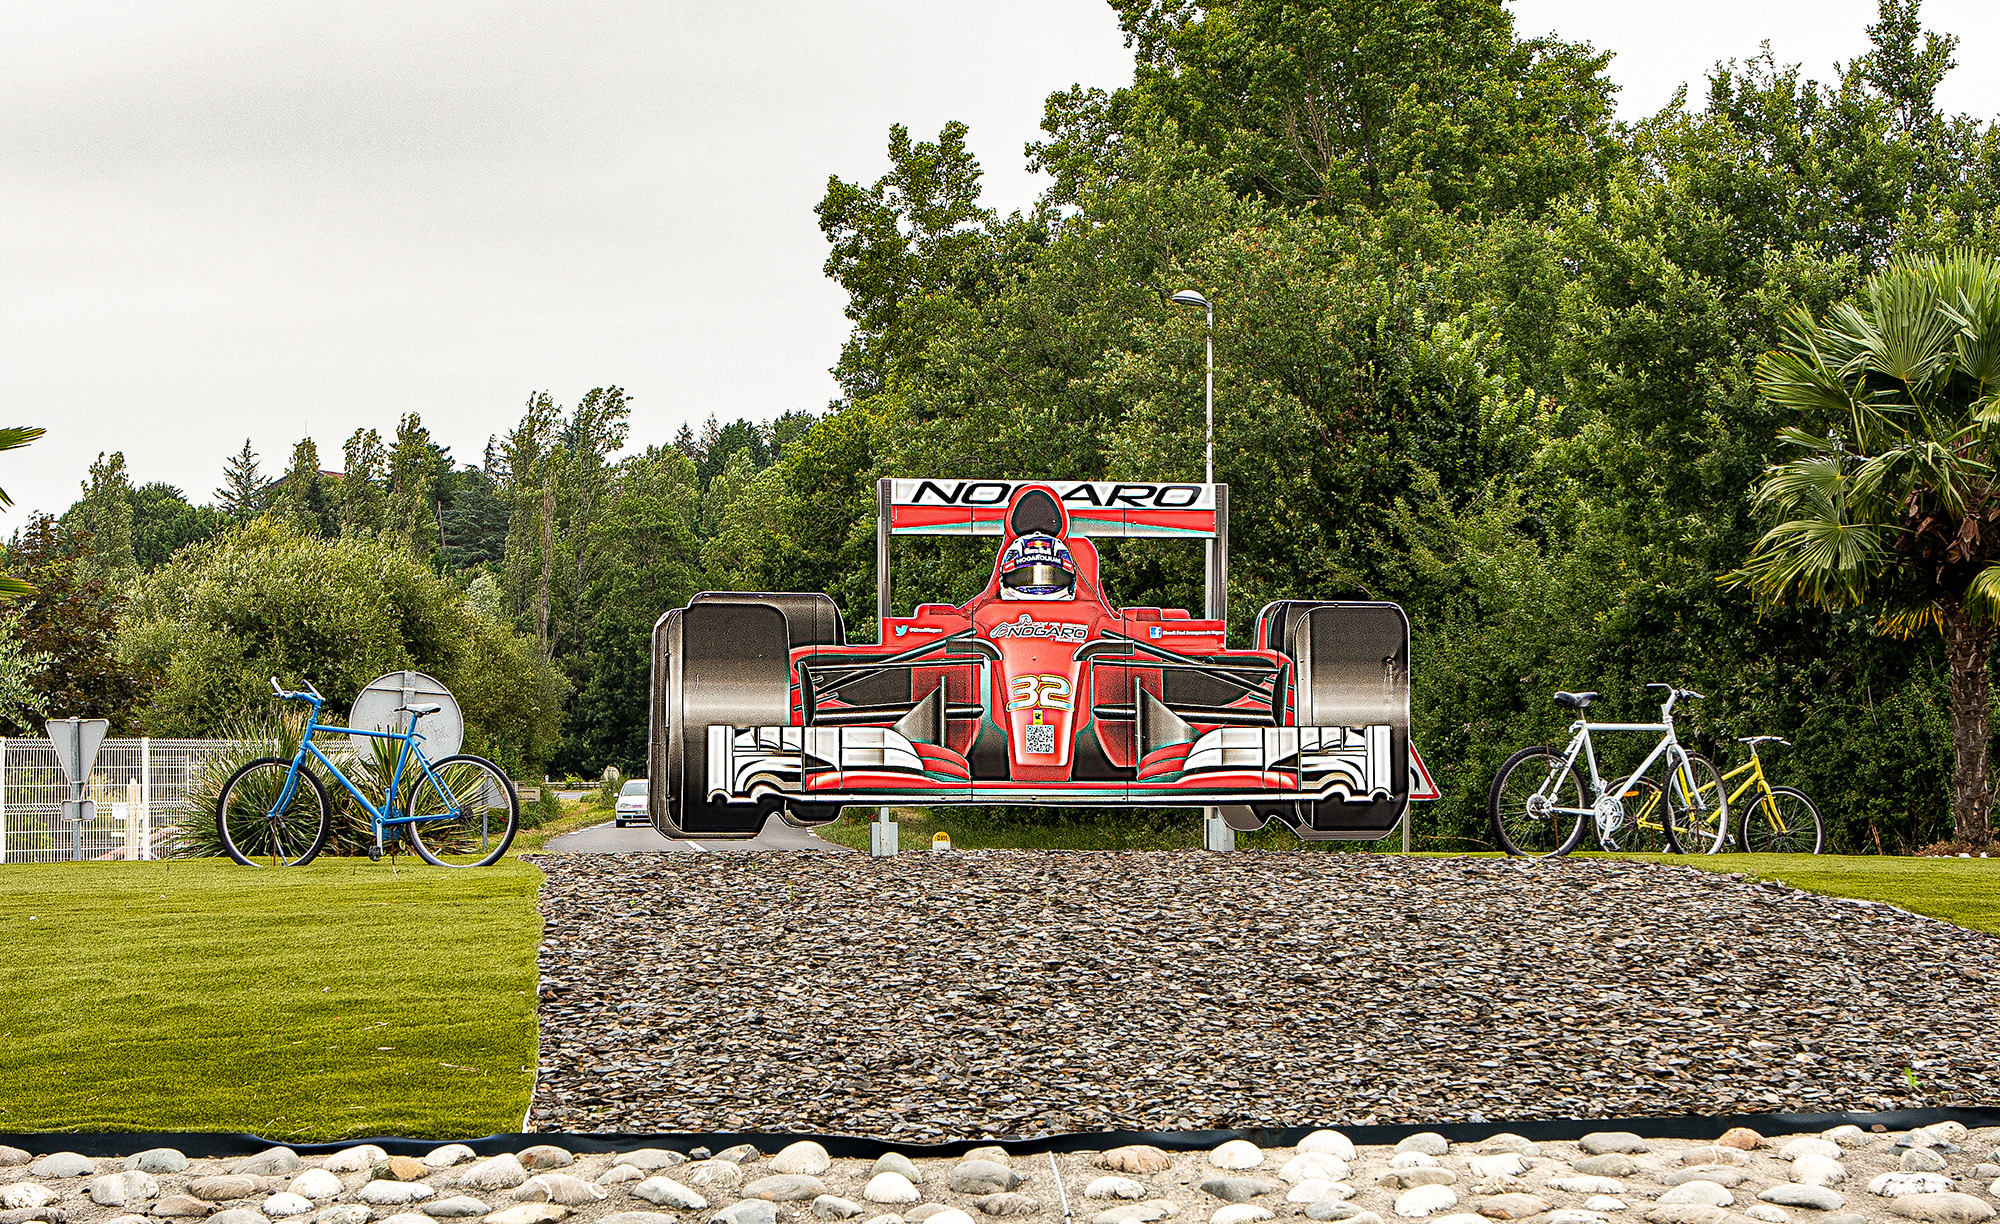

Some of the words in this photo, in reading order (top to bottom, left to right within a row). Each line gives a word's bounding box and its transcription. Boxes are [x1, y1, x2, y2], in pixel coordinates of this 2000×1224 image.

[911, 480, 1202, 507] NOARO
[1006, 625, 1088, 639] NOGARO
[1005, 673, 1075, 713] 32
